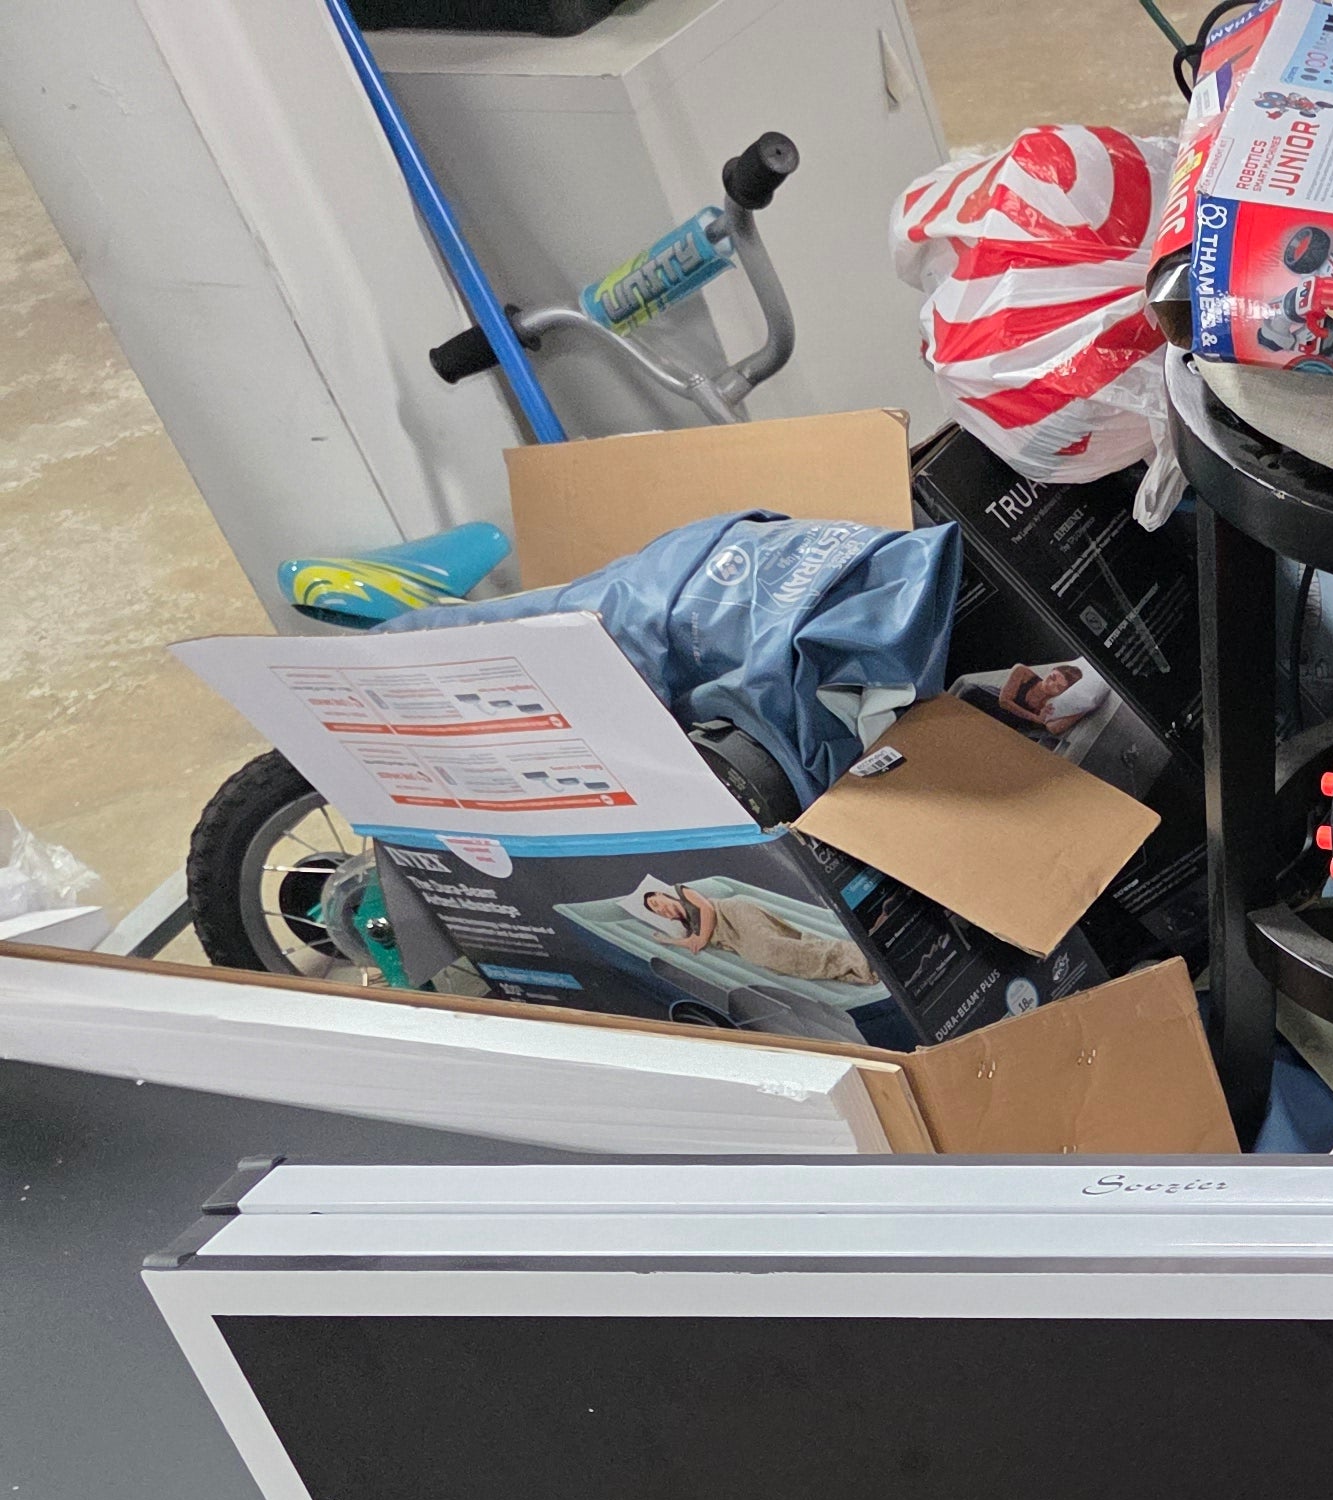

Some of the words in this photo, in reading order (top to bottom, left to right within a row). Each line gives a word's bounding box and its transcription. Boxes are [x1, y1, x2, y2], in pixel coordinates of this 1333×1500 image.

[1235, 139, 1267, 189] ROBOTICS
[1253, 169, 1268, 191] SMART
[1262, 135, 1281, 169] MACHINES
[1267, 119, 1319, 196] JUNIOR
[600, 231, 704, 319] UNITY
[386, 846, 451, 872] INTEX
[979, 967, 1002, 993] PLUS
